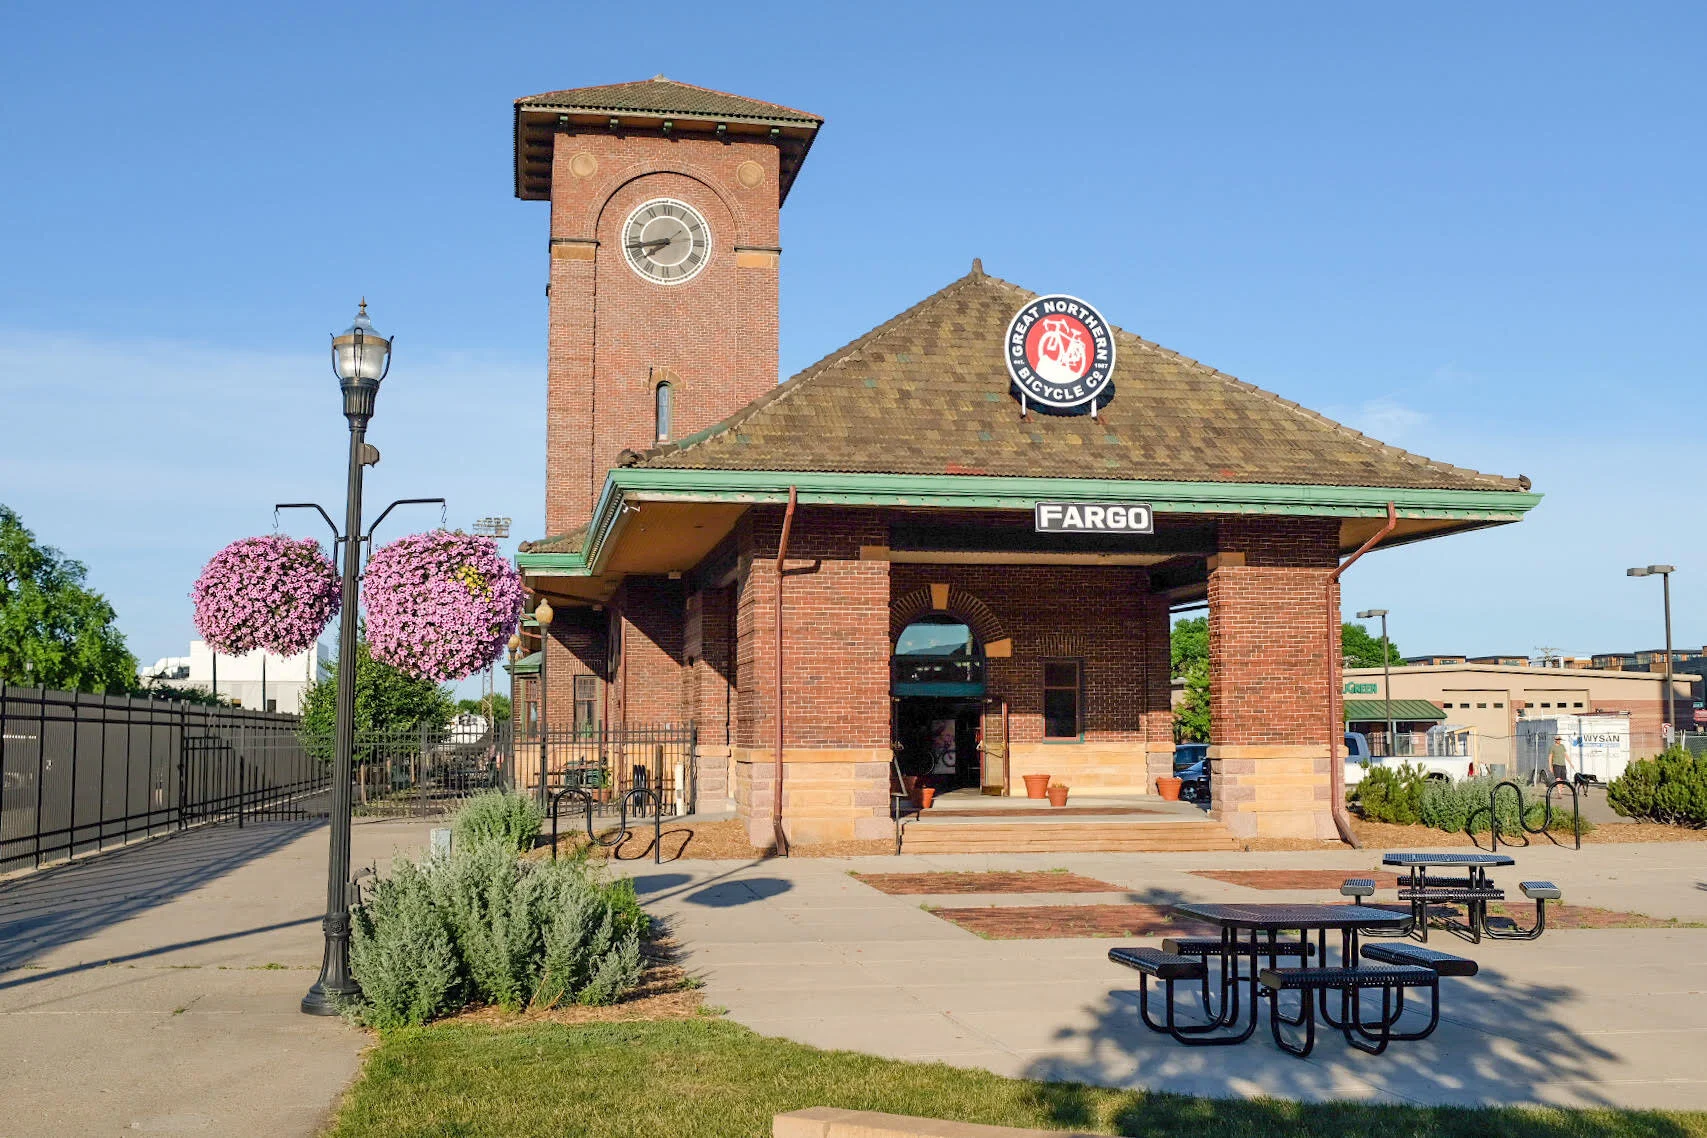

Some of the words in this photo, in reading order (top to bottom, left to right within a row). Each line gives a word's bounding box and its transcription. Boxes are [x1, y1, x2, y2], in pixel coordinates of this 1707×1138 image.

[1012, 306, 1039, 357] GREAT
[1043, 301, 1108, 361] NORTHERN
[1018, 366, 1085, 400] BICYCLE
[1039, 505, 1149, 529] FARGO
[1583, 735, 1620, 743] WYSAN
